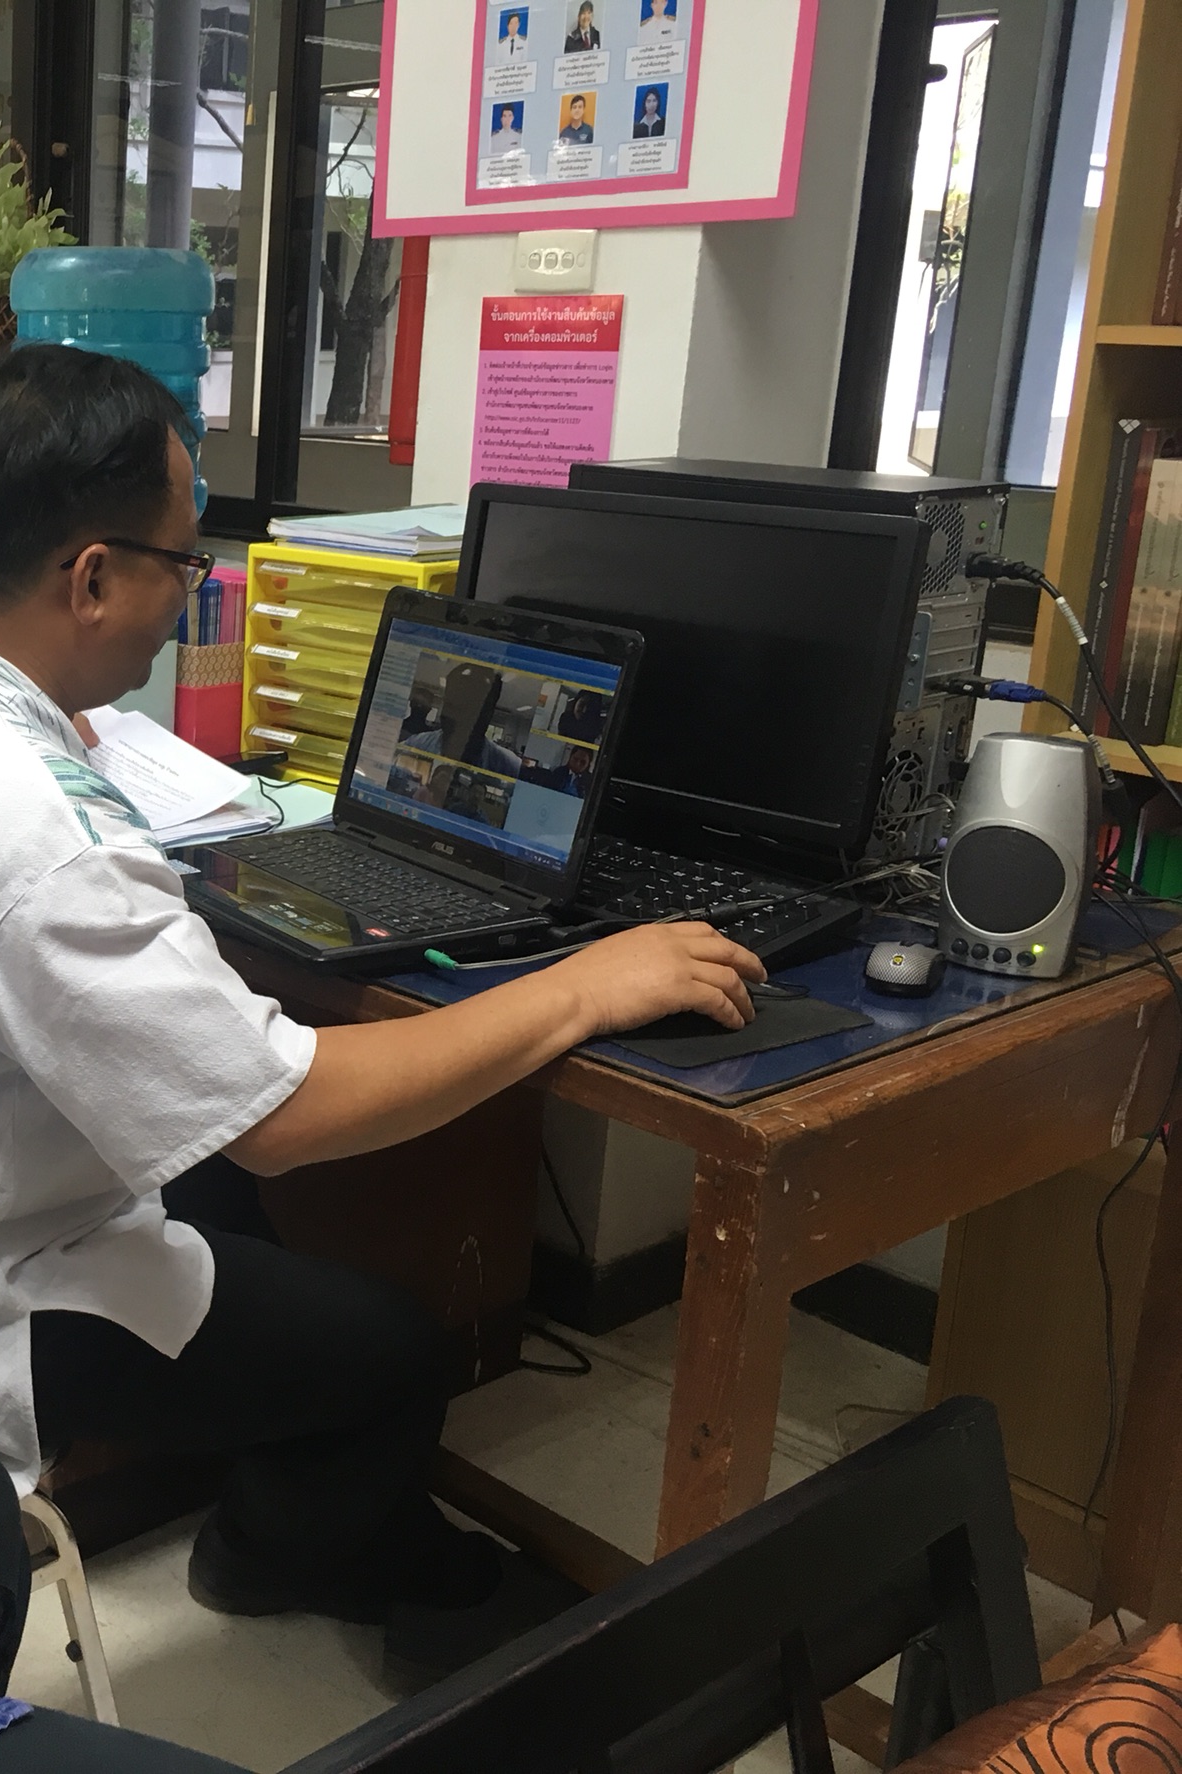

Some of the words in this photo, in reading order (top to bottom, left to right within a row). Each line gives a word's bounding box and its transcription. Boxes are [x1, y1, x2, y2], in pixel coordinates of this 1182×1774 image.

[490, 304, 615, 325] ขั้นตอนการใช้งานสืบค้นข้อมูล
[503, 327, 598, 343] จากเครื่องคอมพิวเตอร์
[431, 841, 455, 856] ASUS
